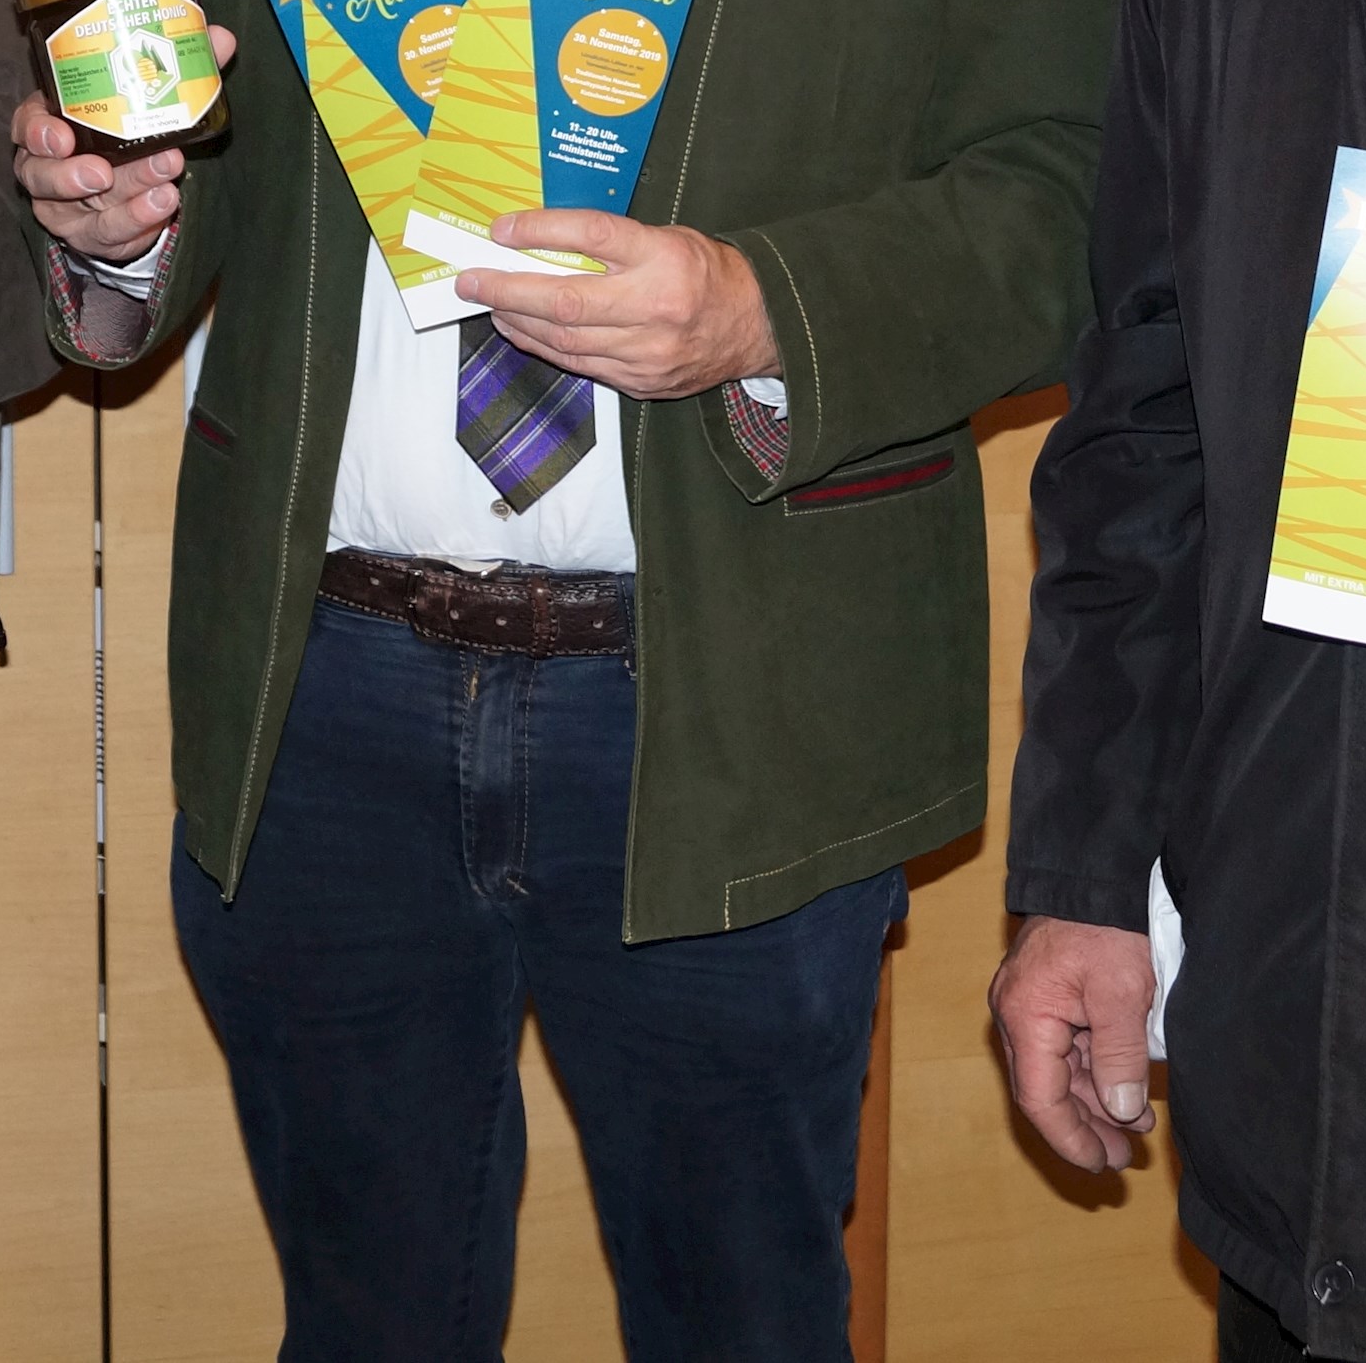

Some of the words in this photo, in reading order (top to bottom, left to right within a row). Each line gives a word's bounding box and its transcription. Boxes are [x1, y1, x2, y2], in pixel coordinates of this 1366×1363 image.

[74, 10, 151, 38] DEUTSHER
[154, 4, 187, 22] HONIG
[573, 33, 587, 44] 30.
[589, 36, 638, 57] November
[639, 49, 661, 62] 2019
[598, 28, 642, 48] Samstag,
[84, 102, 108, 115] 500g
[551, 128, 628, 153] Landwirtschafts-
[600, 128, 619, 141] Uhr
[559, 142, 616, 163] ministerium
[438, 212, 457, 224] MIT
[457, 219, 489, 237] EXTRA
[439, 265, 456, 278] EXT
[1304, 571, 1325, 584] MIT
[1327, 578, 1364, 593] EXTRA
